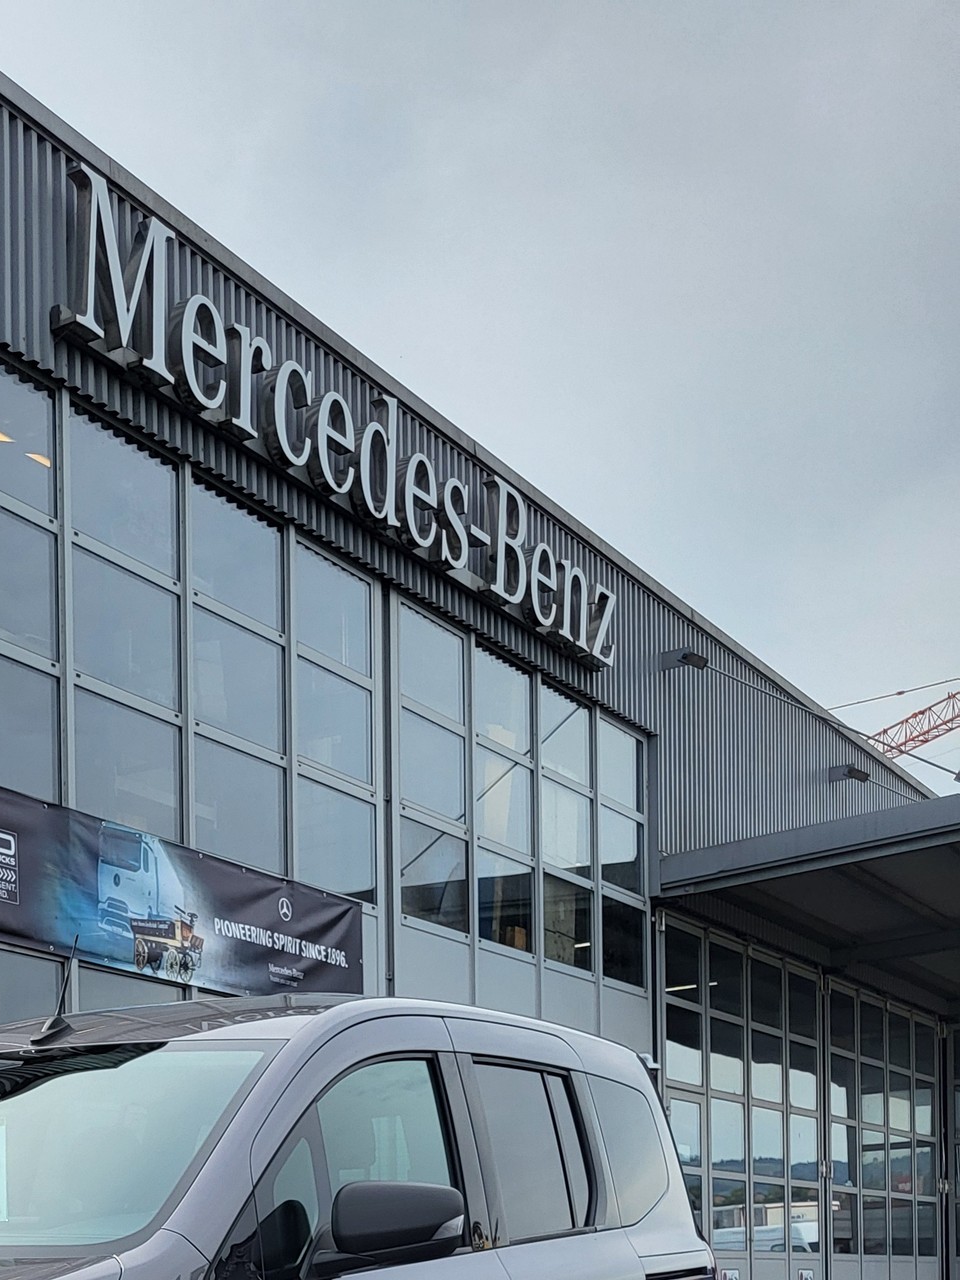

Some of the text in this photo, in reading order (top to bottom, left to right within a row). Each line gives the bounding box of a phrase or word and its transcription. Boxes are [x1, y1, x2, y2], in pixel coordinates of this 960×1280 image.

[74, 161, 618, 669] Mercedes-Benz
[213, 917, 349, 969] PIONEERING SPIRIT SINCE 1896.
